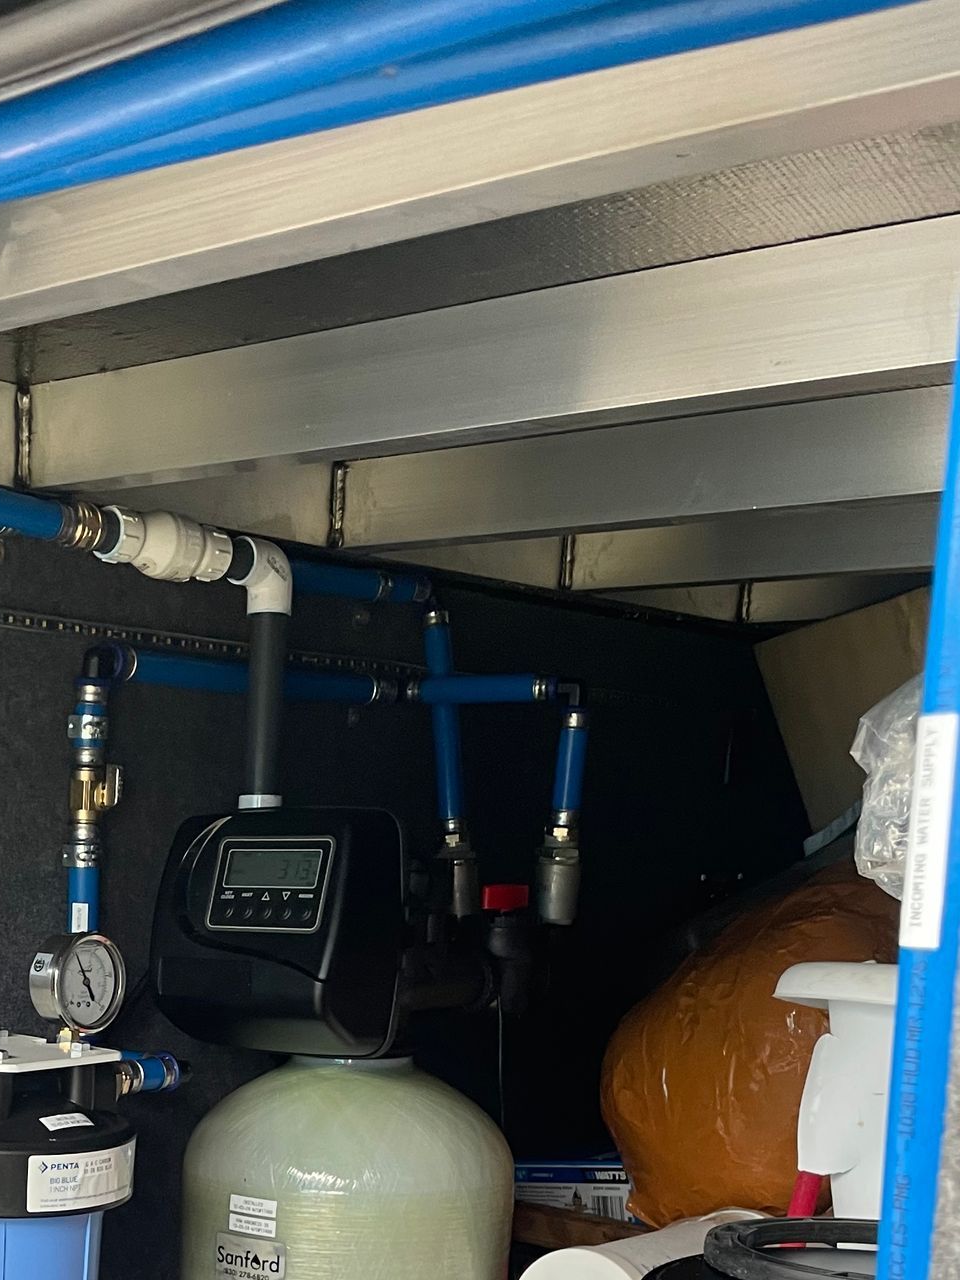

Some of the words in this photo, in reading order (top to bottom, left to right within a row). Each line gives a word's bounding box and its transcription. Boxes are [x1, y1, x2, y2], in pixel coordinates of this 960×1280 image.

[921, 728, 939, 787] SUPPLY
[916, 797, 931, 845] WATER
[909, 852, 927, 927] INCOMING
[61, 1176, 77, 1184] BLUE
[594, 1172, 626, 1180] WATTS
[217, 1246, 280, 1273] Sanford
